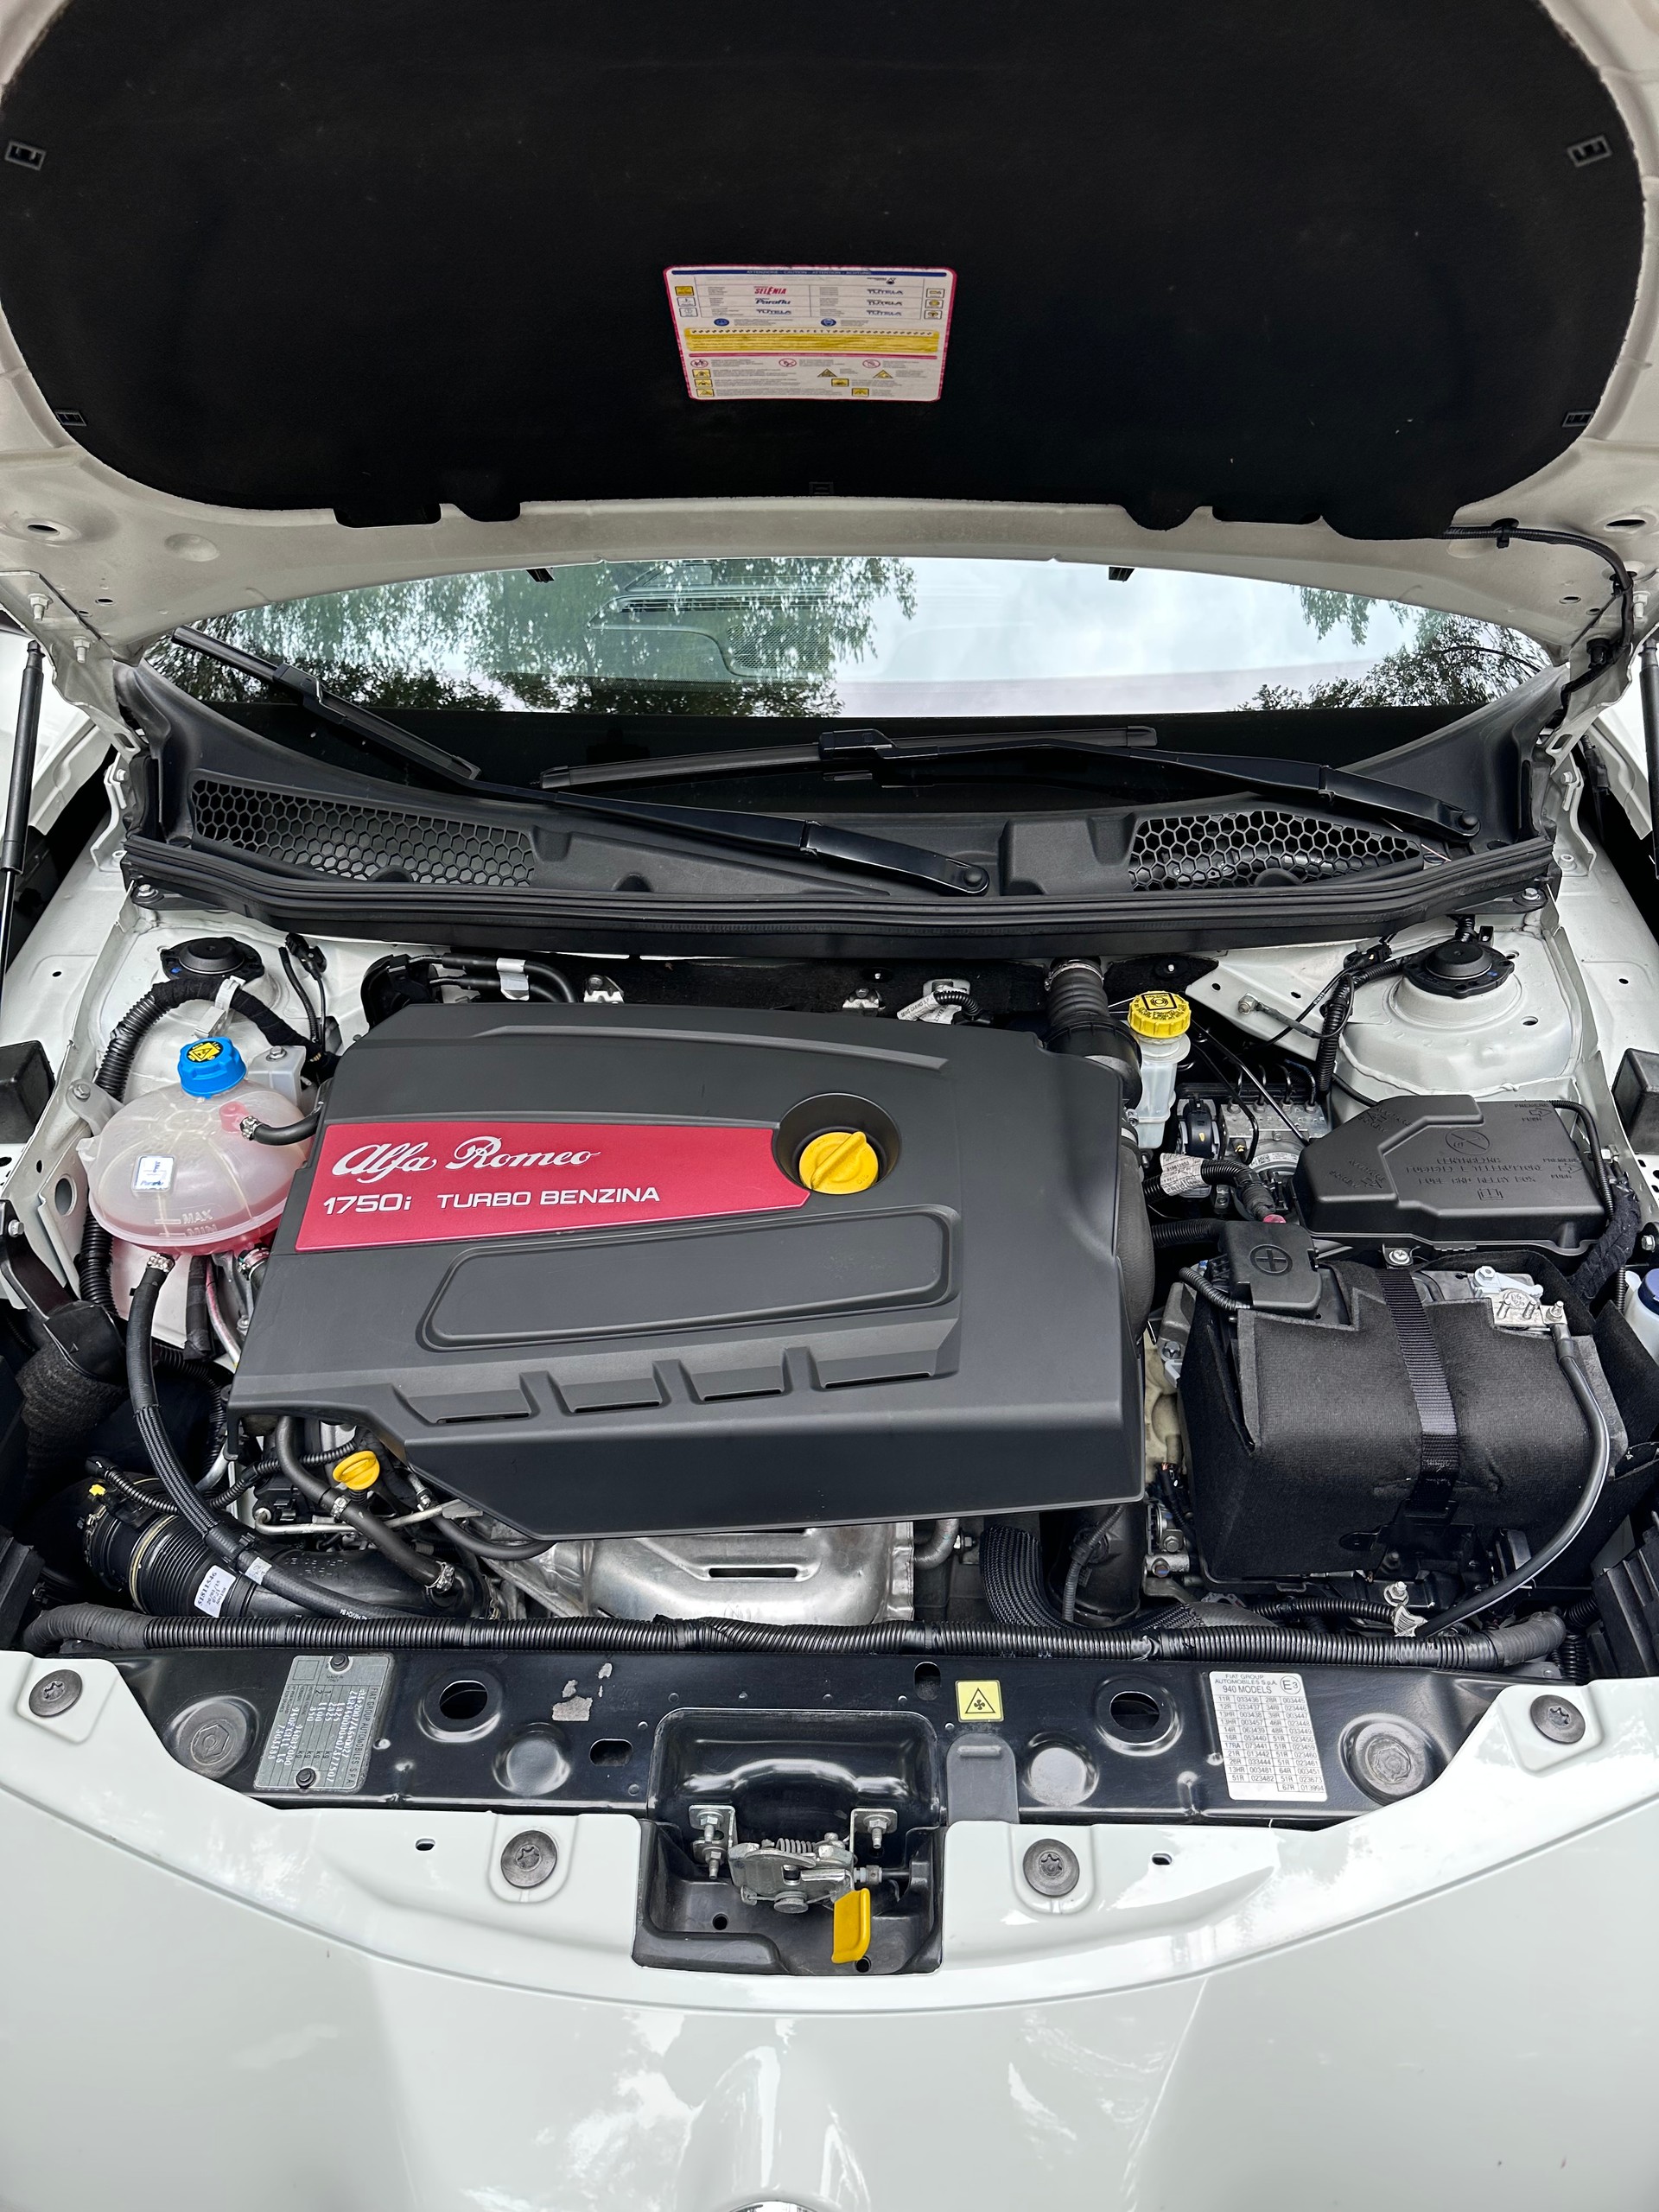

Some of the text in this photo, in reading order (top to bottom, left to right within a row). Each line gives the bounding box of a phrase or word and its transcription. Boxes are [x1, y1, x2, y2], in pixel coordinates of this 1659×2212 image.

[754, 286, 786, 295] SELENIA
[331, 1136, 602, 1184] Alfa Romeo
[323, 1186, 660, 1215] 1750i TURBO BENZINA
[182, 1210, 213, 1224] MAX
[187, 1224, 218, 1237] MIN
[369, 1688, 378, 1701] FIAT
[1238, 1686, 1272, 1694] MODELS
[363, 1702, 374, 1721] GROUP
[352, 1723, 369, 1764] AUTOMOBILES
